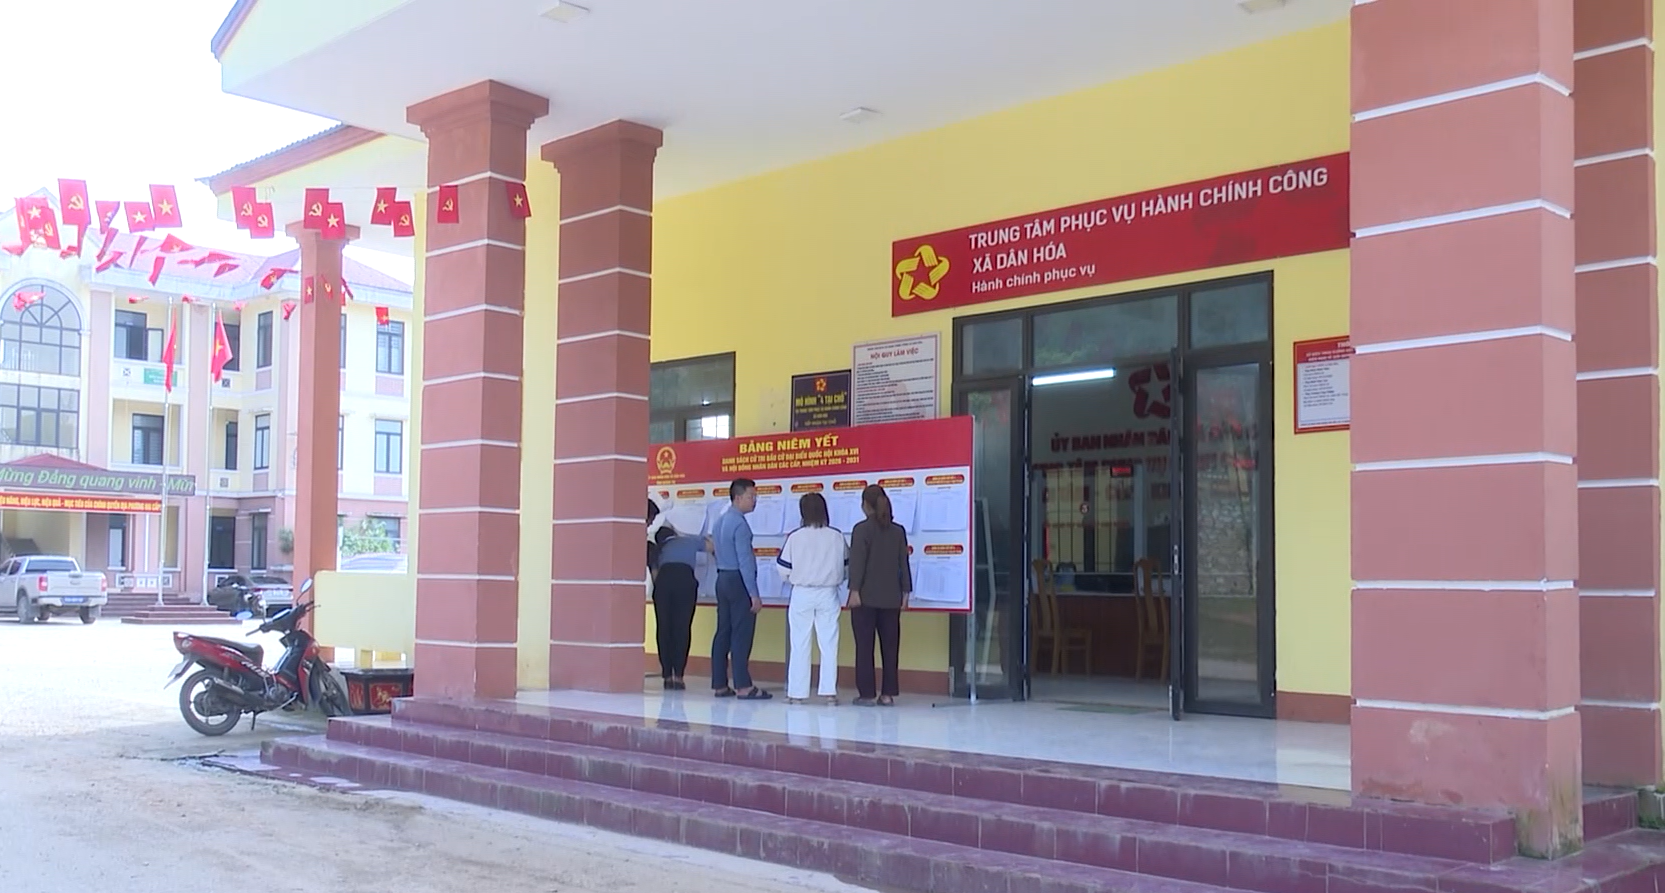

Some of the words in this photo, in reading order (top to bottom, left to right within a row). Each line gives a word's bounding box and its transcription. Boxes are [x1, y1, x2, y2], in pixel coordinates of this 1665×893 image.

[968, 226, 1021, 251] TRUNG
[1024, 217, 1056, 241] TÂM
[1060, 207, 1108, 233] PHỤC
[1111, 202, 1137, 225] VỤ
[1141, 191, 1194, 217] HÀNH
[1199, 178, 1263, 207] CHÍNH
[1268, 166, 1329, 195] CÔNG
[972, 253, 993, 275] XÃ
[996, 247, 1029, 271] DÂN
[1032, 241, 1067, 264] HÓA
[971, 278, 1004, 294] Hành
[1006, 271, 1041, 288] chính
[1044, 266, 1077, 285] phục
[1079, 263, 1097, 280] vụ
[739, 440, 774, 454] BẢNG
[777, 436, 811, 451] NIÊM
[814, 432, 839, 447] YẾT
[846, 456, 860, 464] 2031
[37, 468, 77, 489] Đảng
[79, 474, 125, 492] quang
[128, 475, 157, 491] vinh
